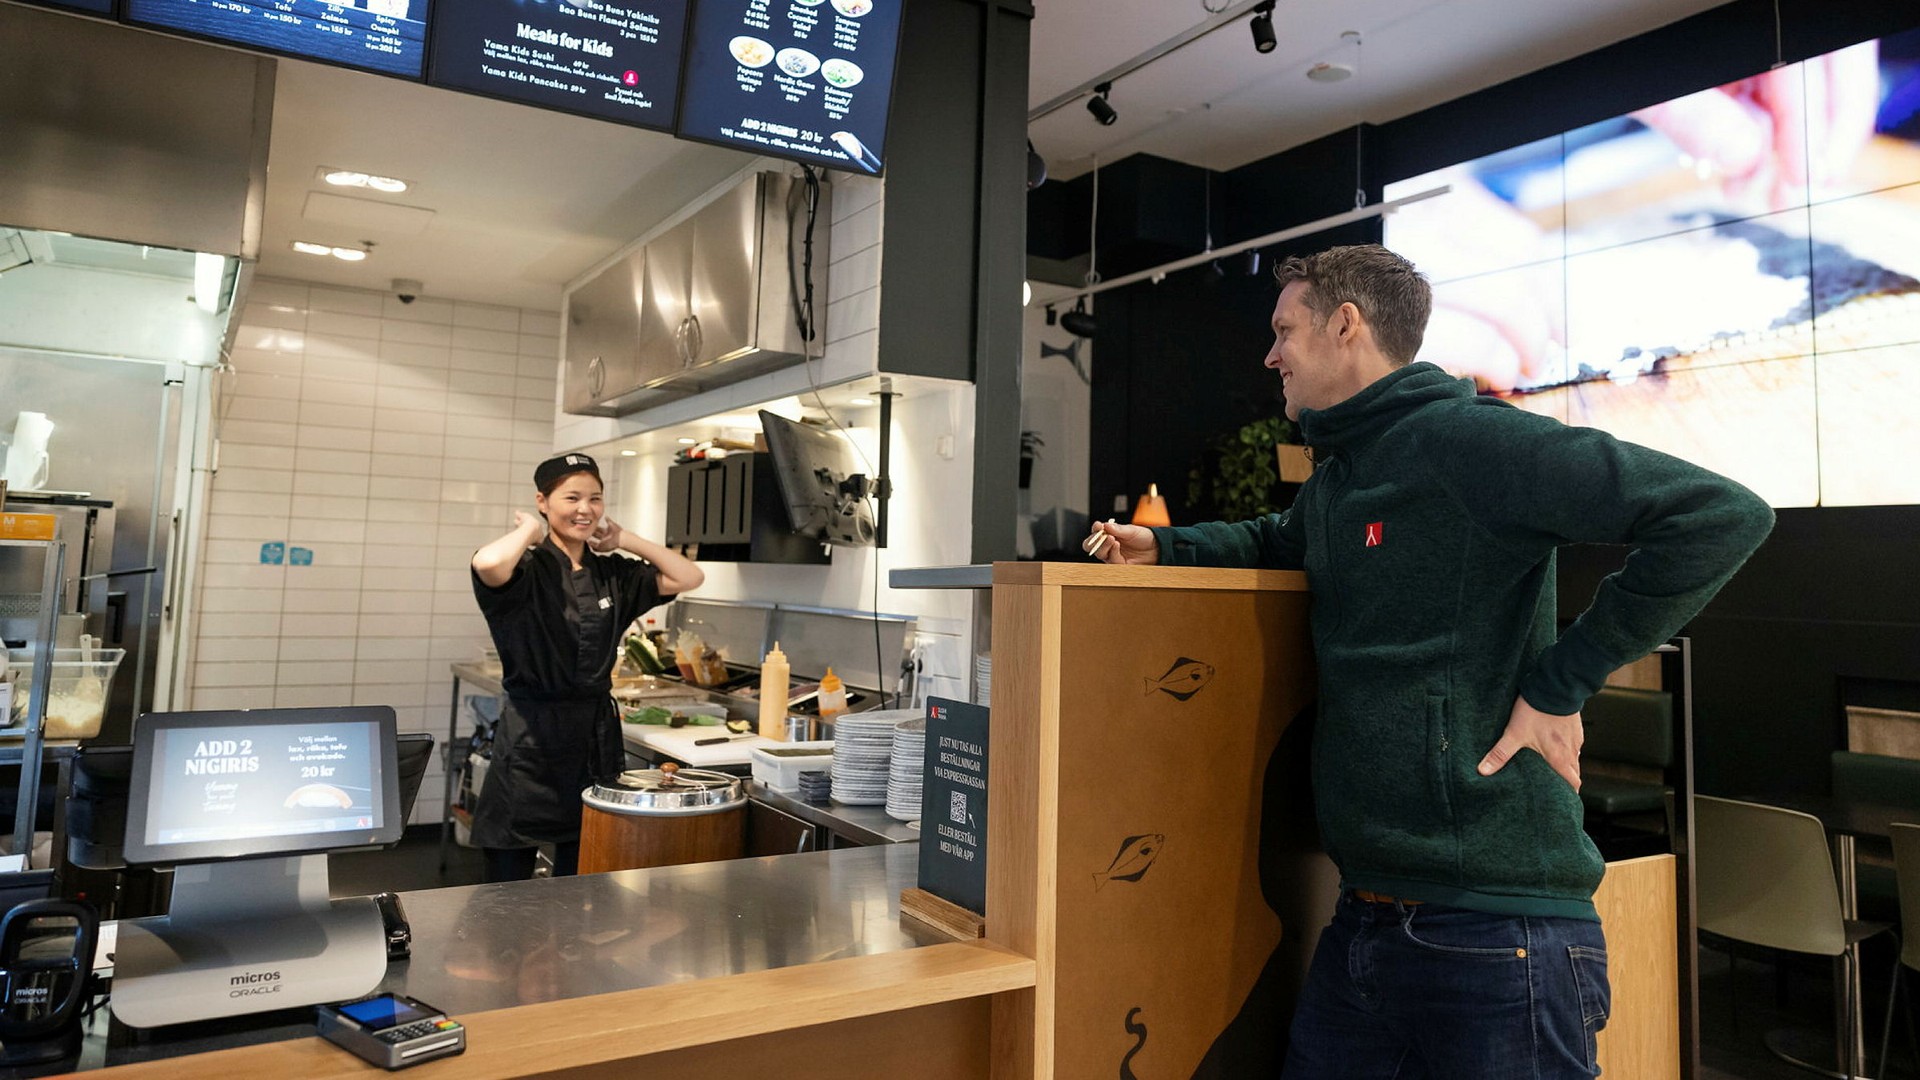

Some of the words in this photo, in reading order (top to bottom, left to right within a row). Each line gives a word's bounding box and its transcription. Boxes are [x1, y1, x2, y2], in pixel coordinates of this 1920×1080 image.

[275, 2, 292, 12] Tofu
[328, 4, 344, 14] Zilly
[588, 0, 604, 11] Bao
[606, 4, 624, 16] Buns
[626, 9, 660, 24] Yakiniku
[294, 17, 302, 25] kr
[376, 15, 396, 26] Spicy
[559, 4, 575, 16] Bao
[577, 8, 597, 20] Buns
[599, 12, 628, 28] Flamed
[630, 21, 658, 35] Salmon
[788, 12, 818, 25] Cucumber
[793, 21, 811, 31] Salad
[516, 23, 559, 46] Meals
[559, 32, 582, 50] for
[582, 38, 613, 58] Kids
[626, 31, 636, 40] pcs
[484, 39, 509, 52] Yama
[511, 45, 530, 56] Kids
[532, 49, 555, 62] Sushi
[497, 52, 516, 61] mellan
[482, 64, 506, 78] Yama
[509, 71, 527, 82] Kids
[530, 75, 568, 90] Pancakes
[738, 66, 763, 78] Popcorn
[774, 74, 795, 85] Nordic
[797, 80, 815, 90] Goma
[780, 84, 807, 96] Wakame
[741, 118, 760, 130] ADD
[760, 122, 766, 131] 2
[801, 130, 813, 141] 20
[814, 132, 823, 143] kr
[721, 127, 733, 138] Välj
[734, 131, 754, 140] mellan
[790, 143, 820, 154] avokado
[298, 736, 313, 744] Välj
[330, 742, 347, 750] tofu
[939, 736, 951, 748] JUST
[951, 738, 958, 750] NU
[958, 740, 969, 752] TAS
[969, 742, 982, 756] ALLA
[194, 740, 237, 757] ADD
[240, 739, 253, 755] 2
[290, 753, 305, 762] och
[306, 752, 345, 761] avokado.
[940, 752, 980, 772] BESTÄLLNINGAR
[185, 756, 259, 775] NIGIRIS
[301, 766, 318, 778] 20
[320, 765, 335, 777] kr
[934, 766, 942, 778] VIA
[943, 768, 985, 790] EXPRESSKASSAN
[938, 823, 954, 838] ELLER
[954, 826, 977, 846] BESTÄLL
[940, 840, 951, 853] MED
[951, 843, 963, 858] VÅR
[963, 848, 974, 861] APP
[230, 970, 281, 987] micros
[16, 987, 48, 996] micros
[229, 984, 282, 998] ORACLE
